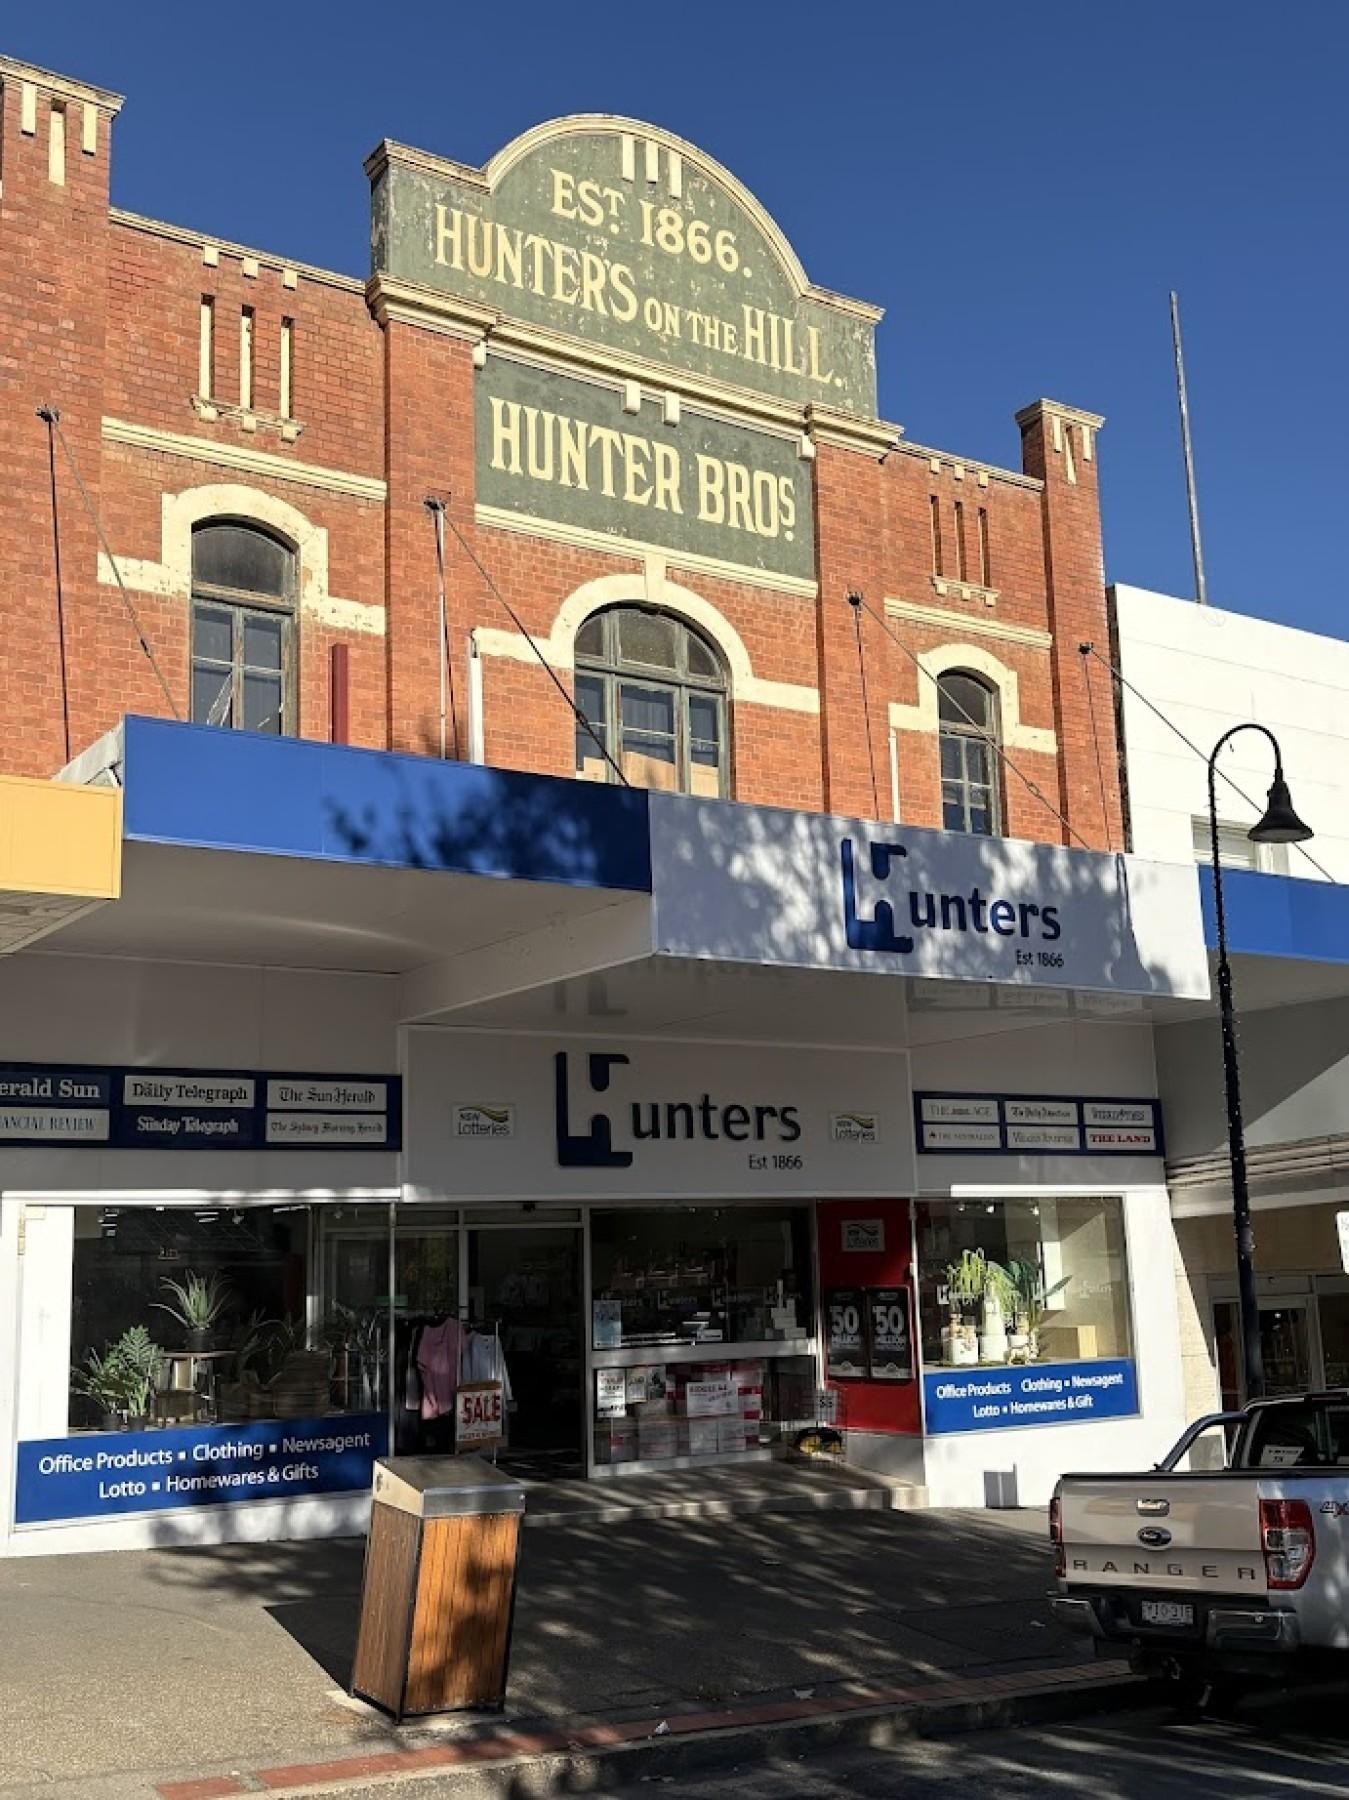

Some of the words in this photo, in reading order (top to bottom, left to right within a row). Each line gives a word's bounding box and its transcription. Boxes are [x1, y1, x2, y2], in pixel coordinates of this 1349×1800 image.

[639, 199, 753, 278] 1866.
[435, 204, 638, 321] HUNTER'S
[644, 297, 681, 338] ON
[687, 309, 739, 355] THE
[741, 303, 843, 388] HILL.
[489, 396, 684, 515] HUNTER
[1016, 948, 1033, 966] Est
[1037, 950, 1065, 969] 1866
[59, 1079, 101, 1099] Sun
[132, 1082, 173, 1102] Daily
[176, 1084, 249, 1104] Telegraph
[279, 1086, 303, 1102] The
[50, 1116, 96, 1131] REVIEW
[137, 1115, 181, 1135] Sunday
[458, 1120, 511, 1137] Lotteries
[834, 1127, 876, 1142] Lotteries
[1117, 1134, 1152, 1144] LAND
[748, 1153, 768, 1171] Est
[772, 1154, 803, 1170] 1866
[936, 1384, 968, 1400] Office
[967, 1381, 1012, 1398] Products
[1021, 1377, 1063, 1394] Clothing
[1071, 1373, 1124, 1390] Newsagent
[462, 1392, 501, 1424] SALE
[972, 1404, 1000, 1418] Lotto
[1010, 1398, 1067, 1415] Homewares
[1067, 1396, 1075, 1409] &
[39, 1455, 93, 1475] Office
[96, 1450, 173, 1471] Products
[192, 1441, 264, 1462] Clothing
[282, 1433, 371, 1454] Newsagent
[99, 1480, 147, 1499] Lotto
[166, 1469, 265, 1493] Homewares
[267, 1466, 280, 1482] &
[282, 1463, 319, 1481] Gifts
[1072, 1558, 1257, 1581] RANGER
